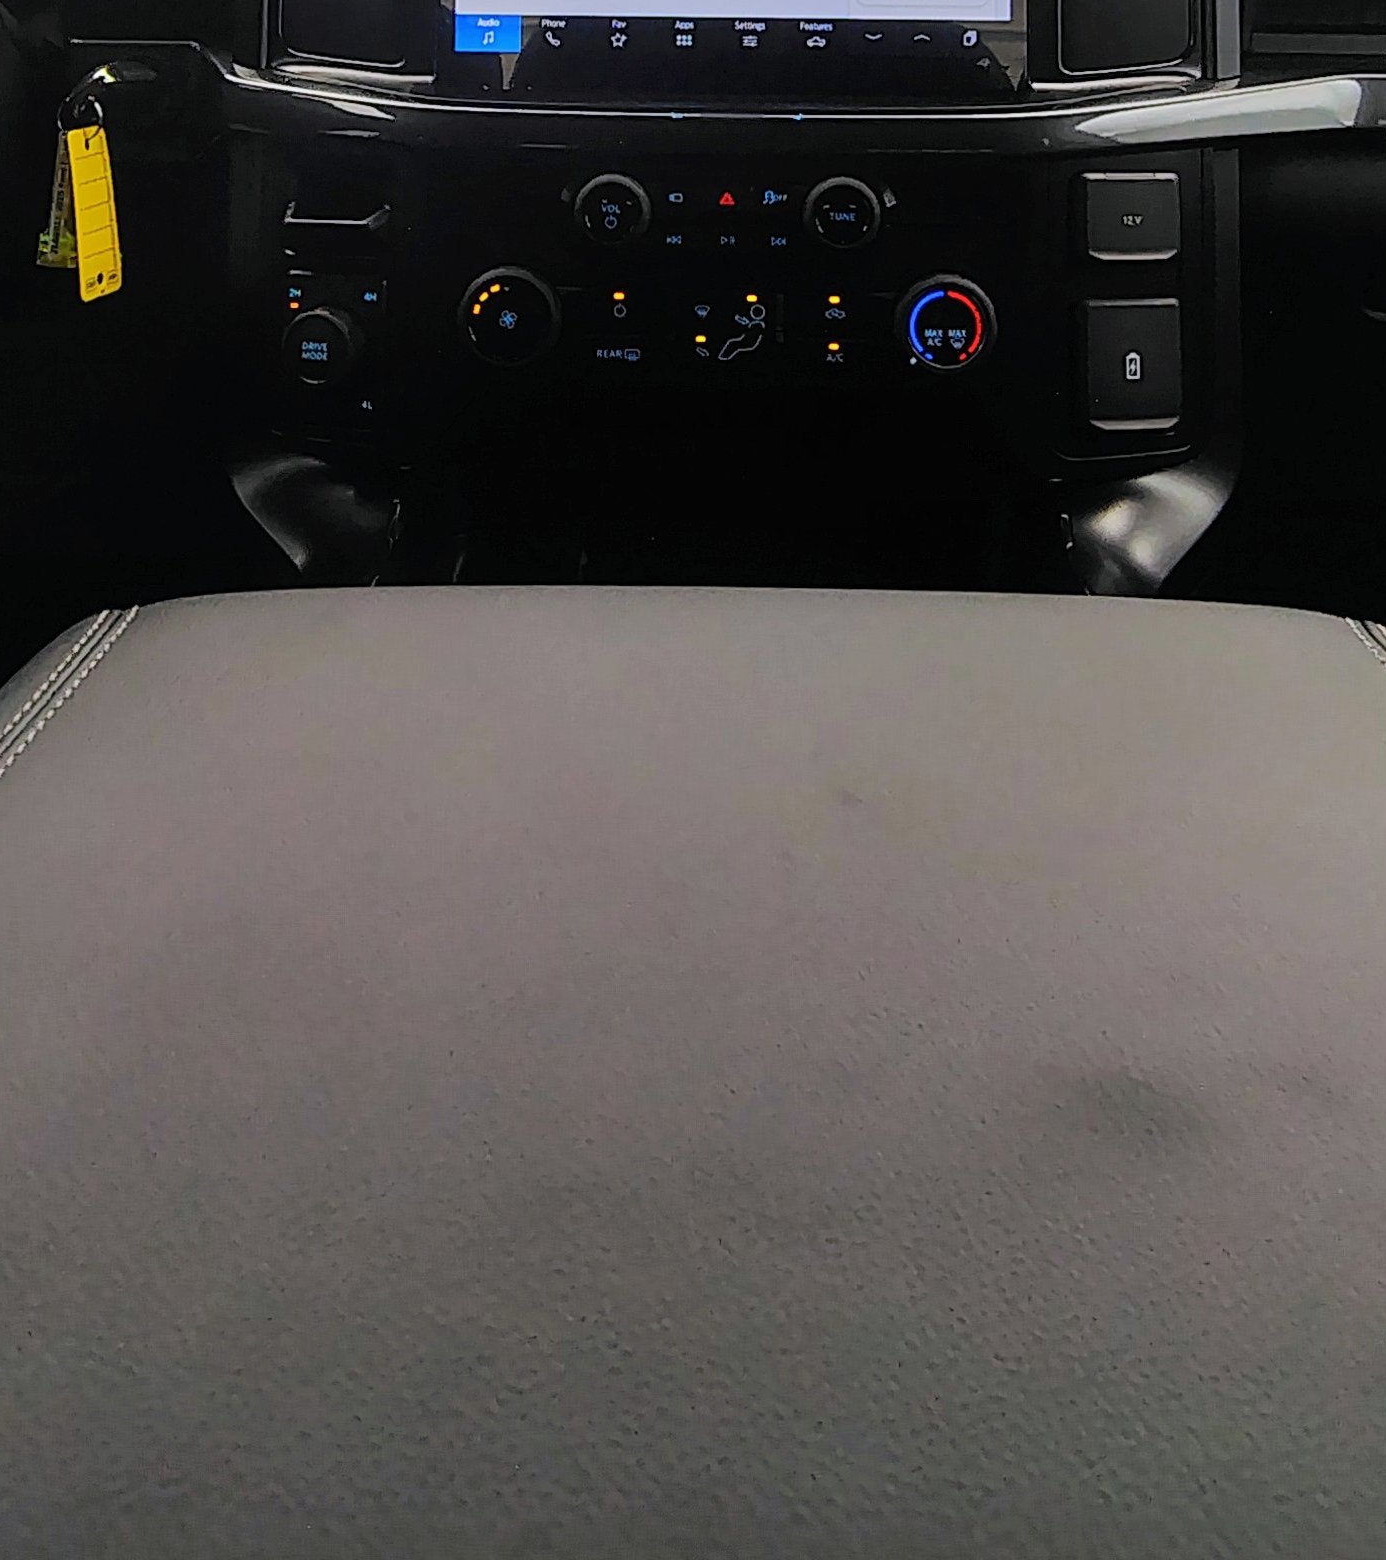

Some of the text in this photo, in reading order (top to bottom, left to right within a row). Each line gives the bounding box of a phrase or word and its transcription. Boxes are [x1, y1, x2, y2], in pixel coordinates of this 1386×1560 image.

[477, 18, 500, 27] Audio
[541, 19, 566, 29] Phone
[612, 19, 627, 28] Fav
[675, 21, 694, 30] Apps
[734, 21, 766, 31] Settings
[799, 21, 833, 32] Features
[601, 203, 621, 214] VOL
[829, 212, 857, 222] TUNE
[1122, 215, 1143, 226] 12V
[289, 288, 301, 297] 2H
[924, 329, 943, 338] MAX
[948, 329, 966, 338] MAX
[301, 341, 328, 351] DRIVE
[301, 351, 328, 361] MODE
[596, 349, 623, 359] REAR
[826, 353, 845, 363] A/C
[361, 400, 373, 410] 4L
